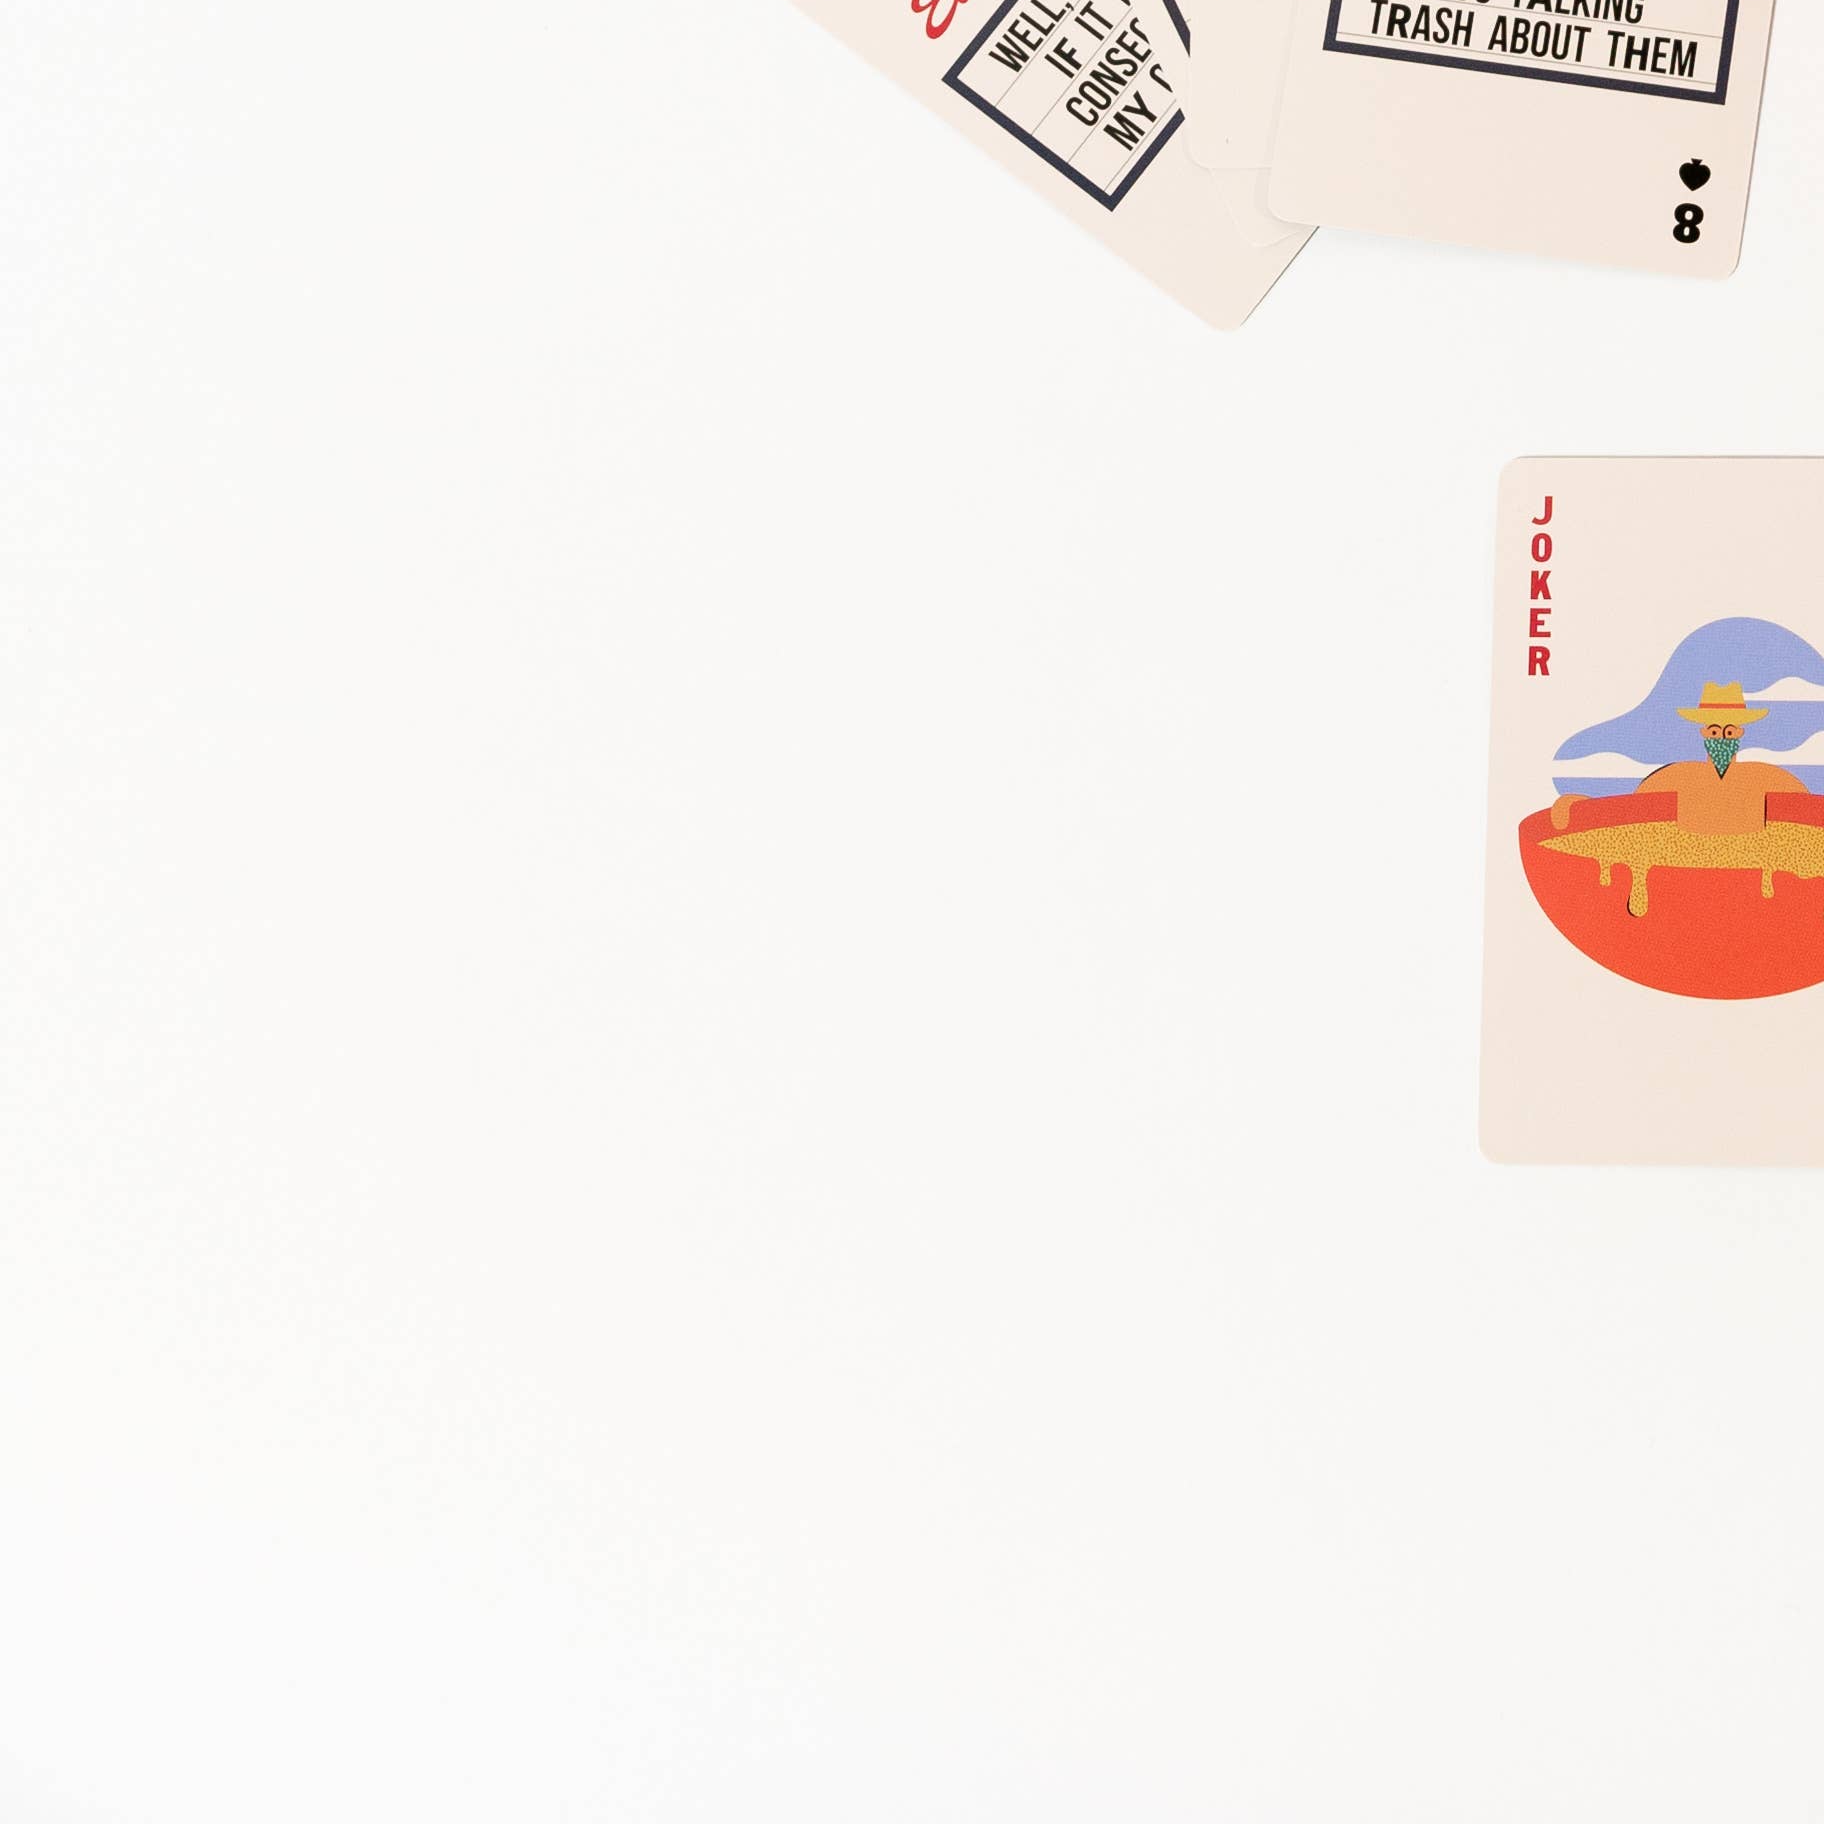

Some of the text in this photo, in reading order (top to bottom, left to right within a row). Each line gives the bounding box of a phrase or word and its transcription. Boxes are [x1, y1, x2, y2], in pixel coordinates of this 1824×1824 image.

[1044, 37, 1083, 80] IF
[1074, 0, 1115, 41] IT
[1486, 14, 1592, 62] ABOUT
[1606, 29, 1699, 78] THEM
[1103, 89, 1158, 152] MY
[1672, 202, 1704, 244] 8
[1526, 495, 1554, 677] JOKER
